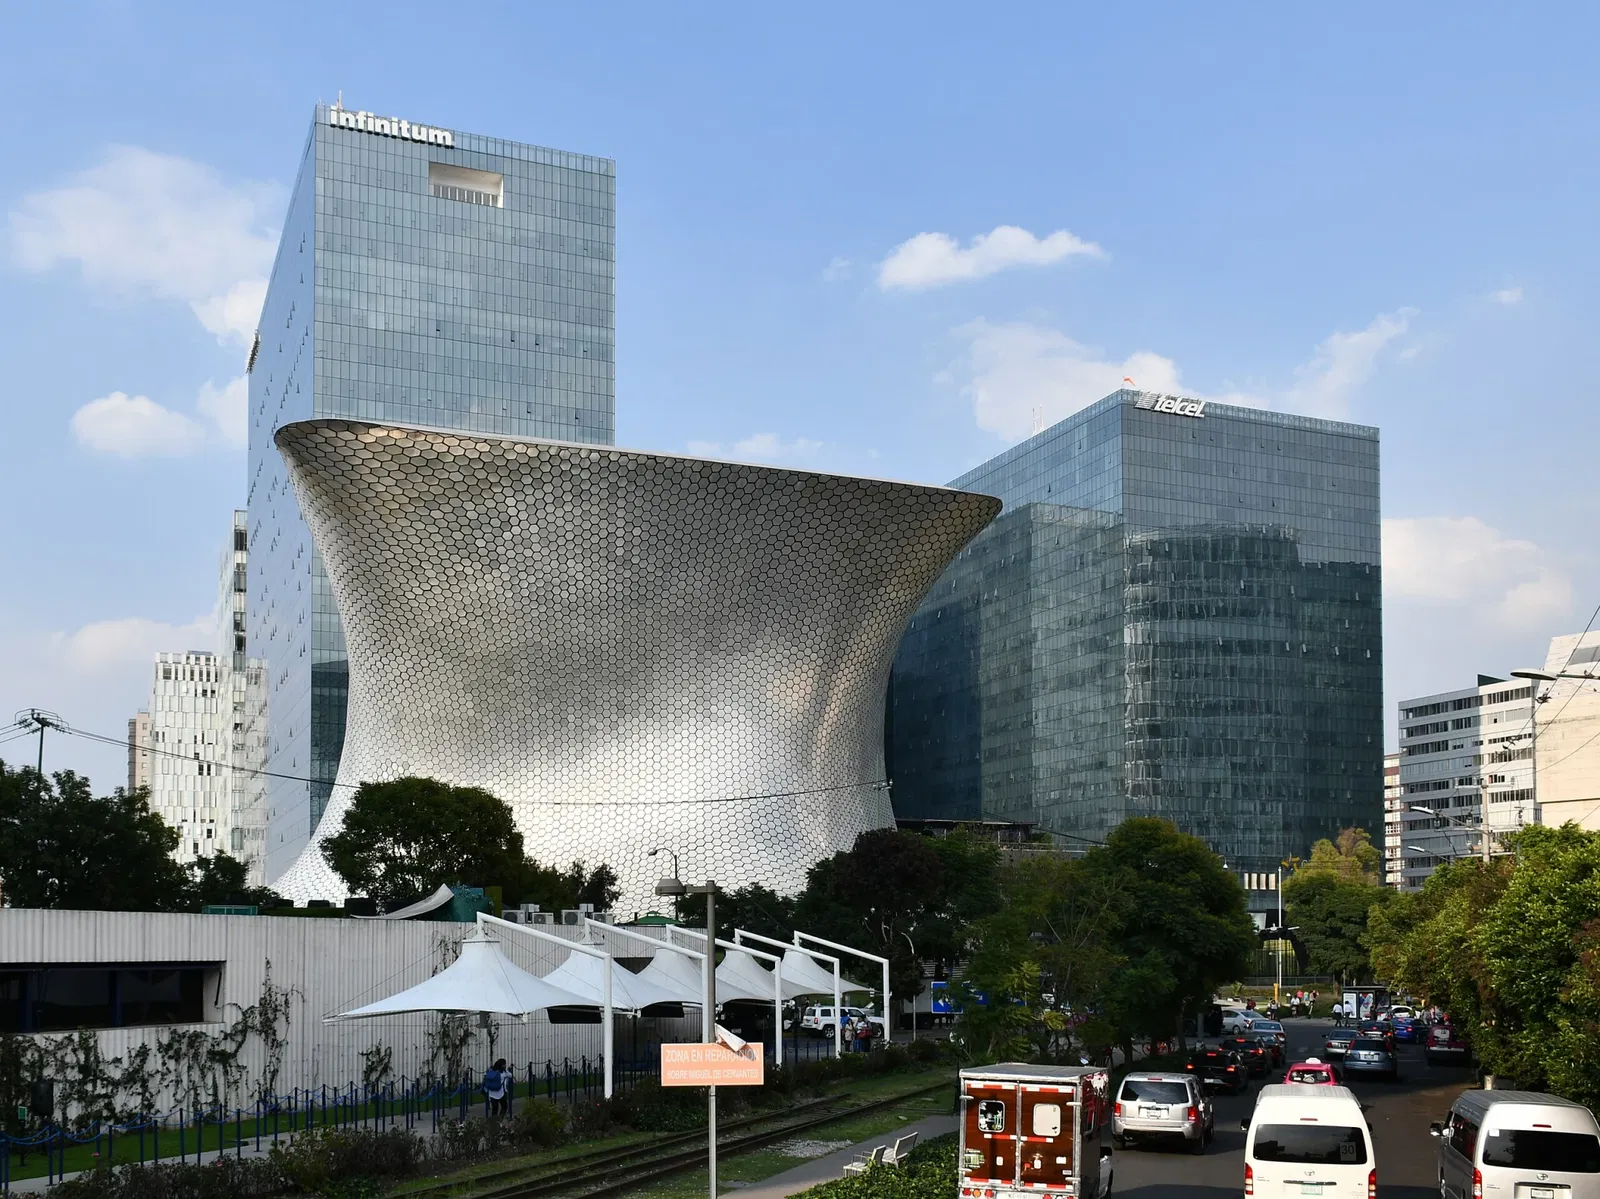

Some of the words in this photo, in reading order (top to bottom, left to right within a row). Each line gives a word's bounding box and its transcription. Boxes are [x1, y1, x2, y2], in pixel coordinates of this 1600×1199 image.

[330, 105, 453, 146] infinitum
[1154, 395, 1205, 418] telcel
[665, 1050, 690, 1063] ZONA
[691, 1049, 703, 1062] EN
[1341, 1144, 1355, 1155] 30
